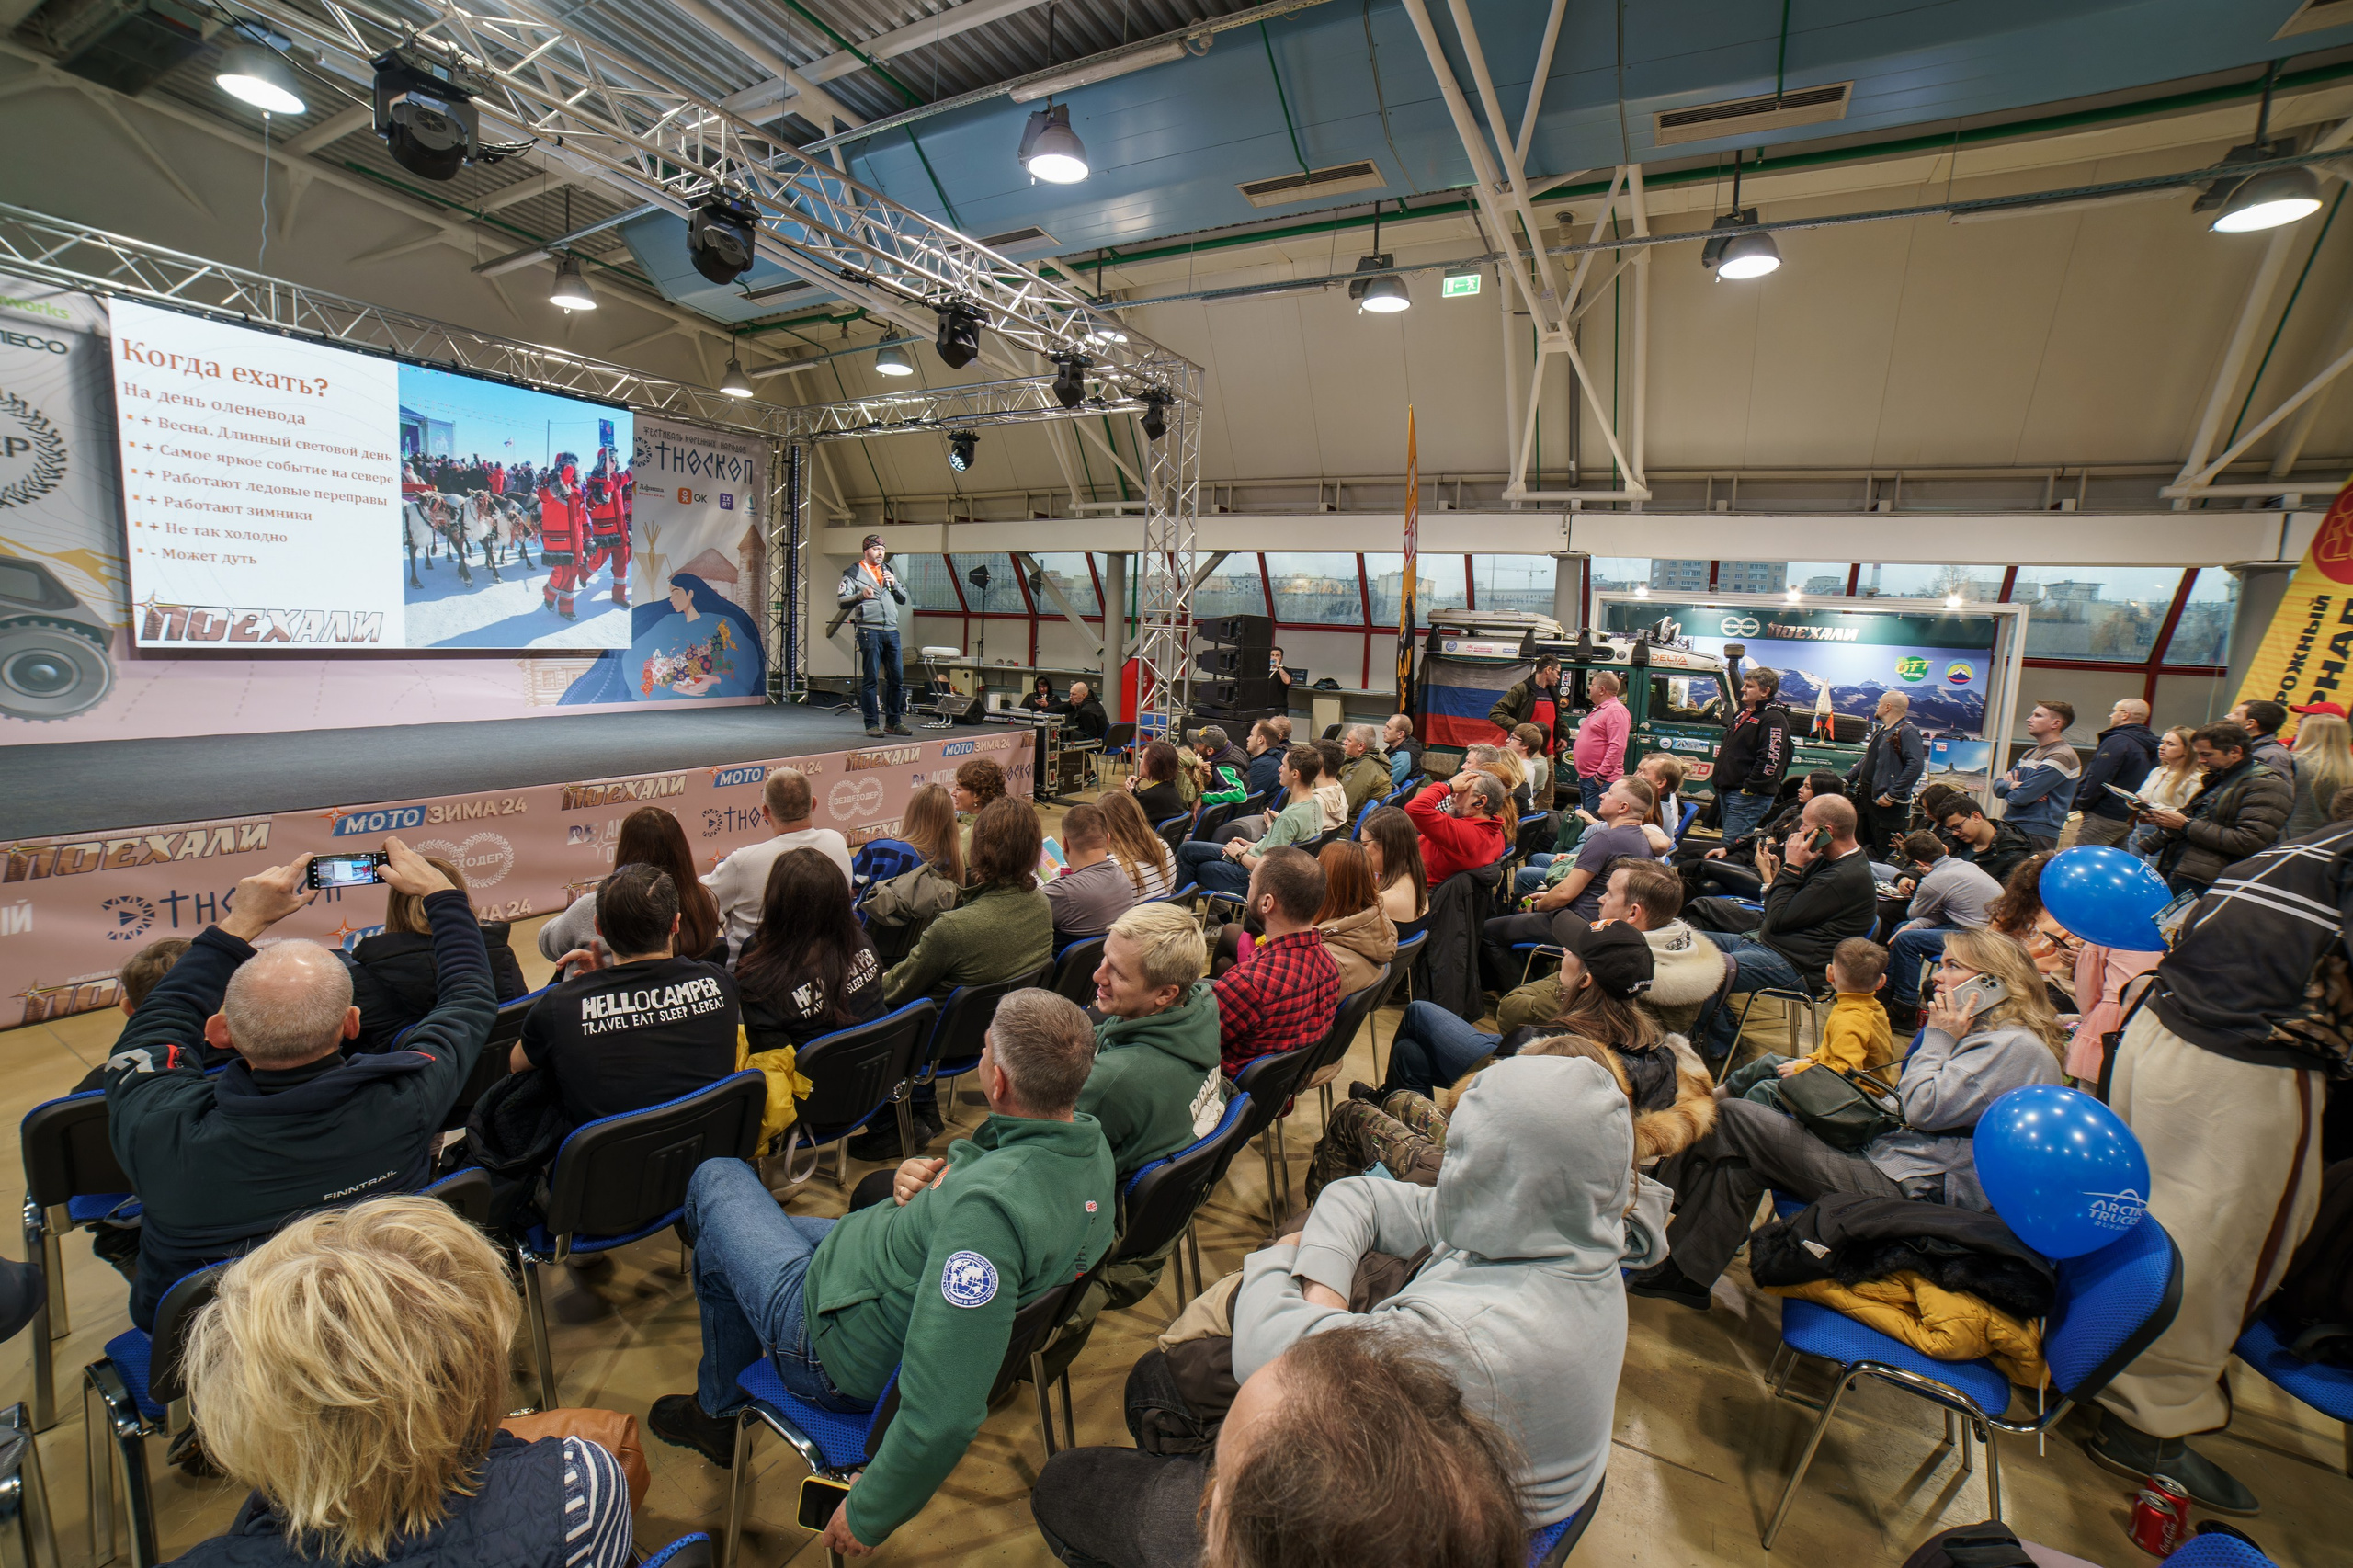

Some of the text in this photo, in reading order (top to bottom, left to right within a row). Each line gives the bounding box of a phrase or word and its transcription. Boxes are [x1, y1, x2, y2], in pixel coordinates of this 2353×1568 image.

[120, 338, 329, 397] Когда ехать?
[123, 381, 306, 426] На день оленевода
[158, 417, 213, 436] Весна.
[217, 426, 291, 448] Длинный
[295, 440, 358, 457] световой
[361, 449, 392, 461] день
[160, 444, 212, 460] Самое
[216, 454, 263, 468] яркое
[267, 460, 328, 476] событие
[332, 469, 347, 479] на
[351, 472, 394, 485] севере
[162, 470, 242, 490] Работают
[245, 482, 311, 497] ледовые
[314, 490, 388, 506] переправы
[164, 496, 244, 515] Работают
[246, 507, 313, 521] зимники
[165, 522, 188, 534] Не
[192, 527, 221, 538] так
[225, 529, 288, 542] холодно
[162, 548, 218, 562] Может
[222, 554, 257, 565] дуть
[140, 605, 384, 642] ПОЕХАЛИ
[1766, 624, 1859, 641] ПОЕХАЛИ
[1651, 653, 1688, 665] DELTA
[2273, 595, 2333, 707] РОЖНЫЙ
[845, 746, 922, 772] ПОЕХАЛИ
[946, 743, 972, 756] МОТО
[974, 740, 999, 754] ЗИМА
[1000, 738, 1011, 749] 24
[720, 768, 762, 787] МОТО
[808, 761, 823, 775] 24
[561, 775, 687, 811] ПОЕХАЛИ
[834, 790, 880, 805] ВЕЗДЕХОДЕР
[344, 796, 528, 834] МОТО ЗИМА 24
[2, 822, 272, 883] ПОЕХАЛИ
[507, 898, 533, 917] 24
[582, 977, 722, 1020] HELLOCAMPER
[847, 975, 864, 994] SLEEP
[582, 996, 725, 1035] TRAVEL EAT SLEEP REPEAT
[324, 1169, 398, 1201] FINNTRAIL
[2089, 1208, 2141, 1225] TRUCKS
[2090, 1199, 2144, 1217] ARCTIC
